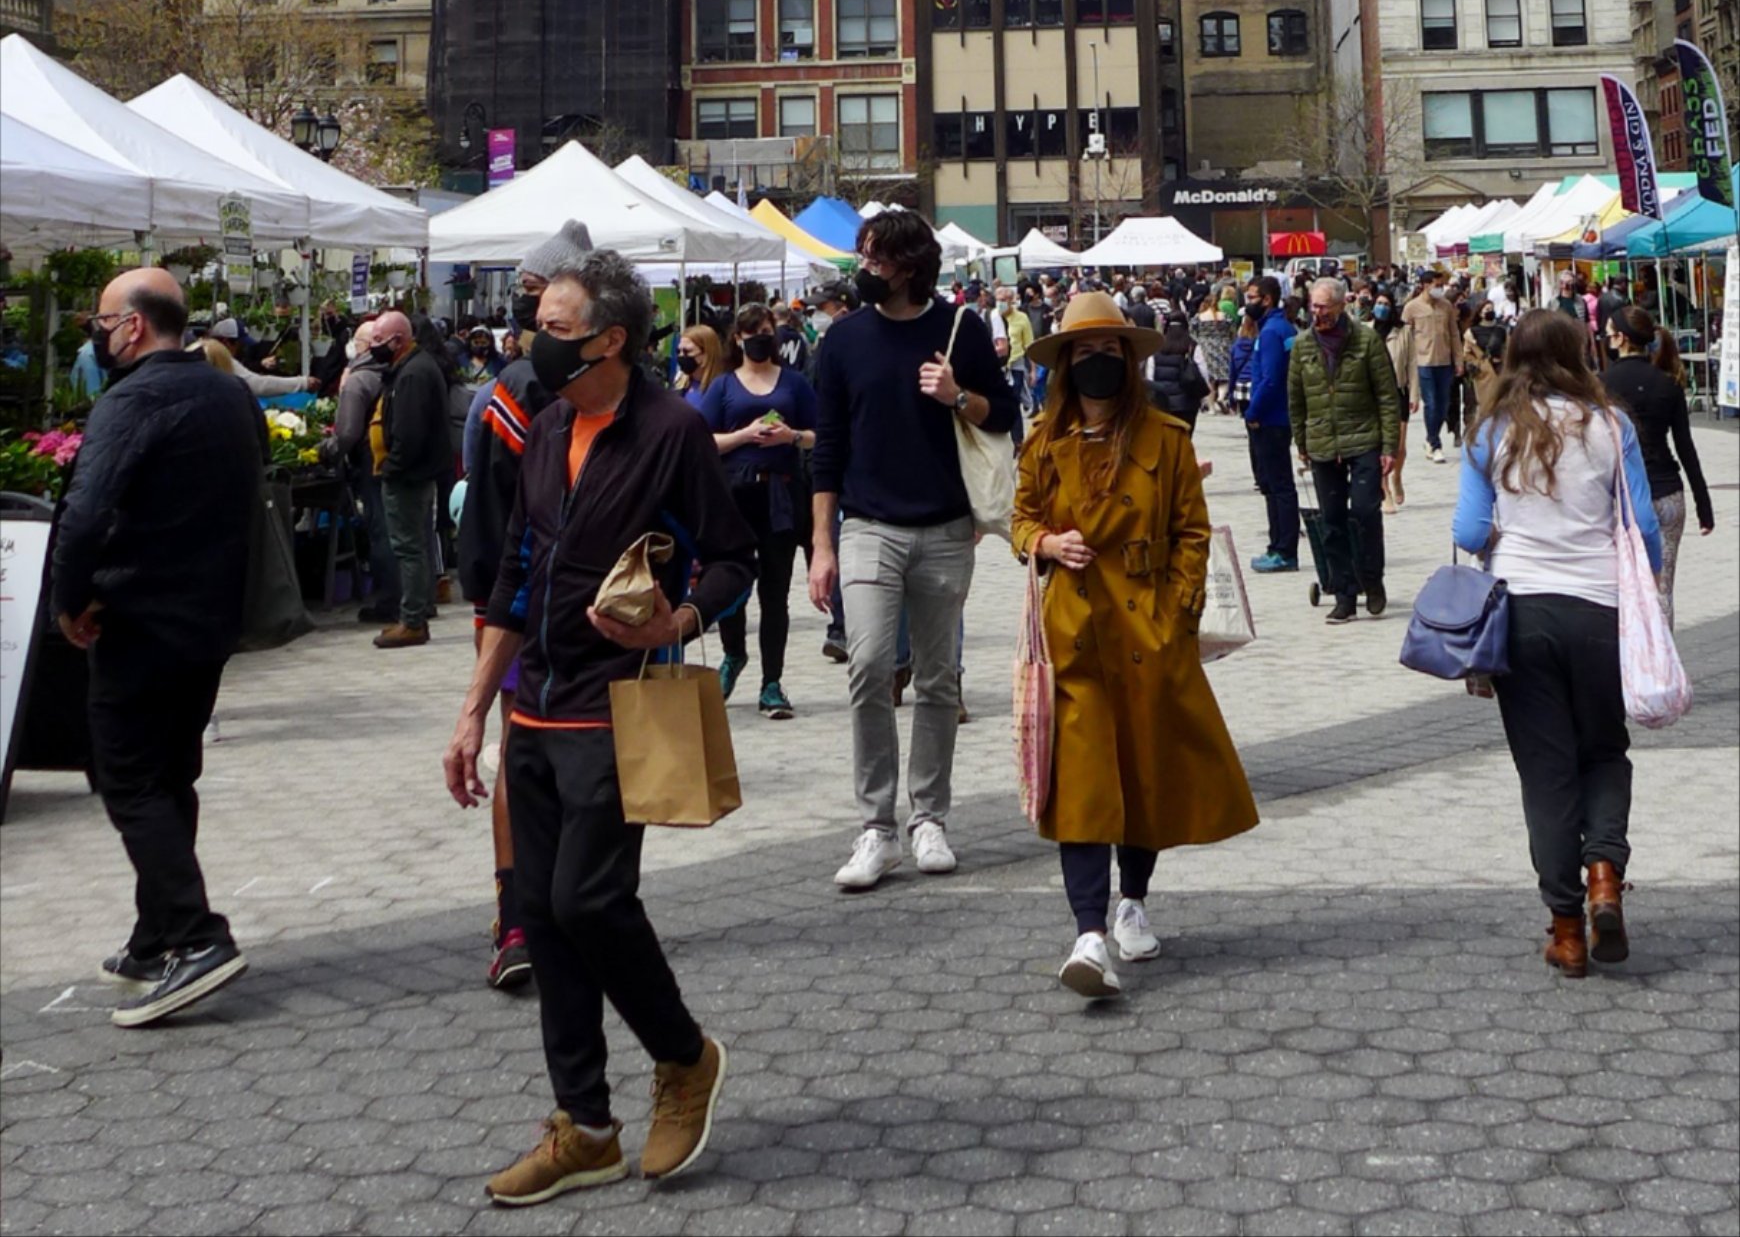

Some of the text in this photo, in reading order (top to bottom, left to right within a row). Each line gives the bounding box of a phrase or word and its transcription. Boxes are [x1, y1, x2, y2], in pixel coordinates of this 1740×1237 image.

[1624, 101, 1641, 134] GIN
[1684, 77, 1711, 179] GRASS
[1703, 97, 1725, 157] FED
[1173, 187, 1277, 204] McDonald's
[1634, 156, 1656, 217] VODKA
